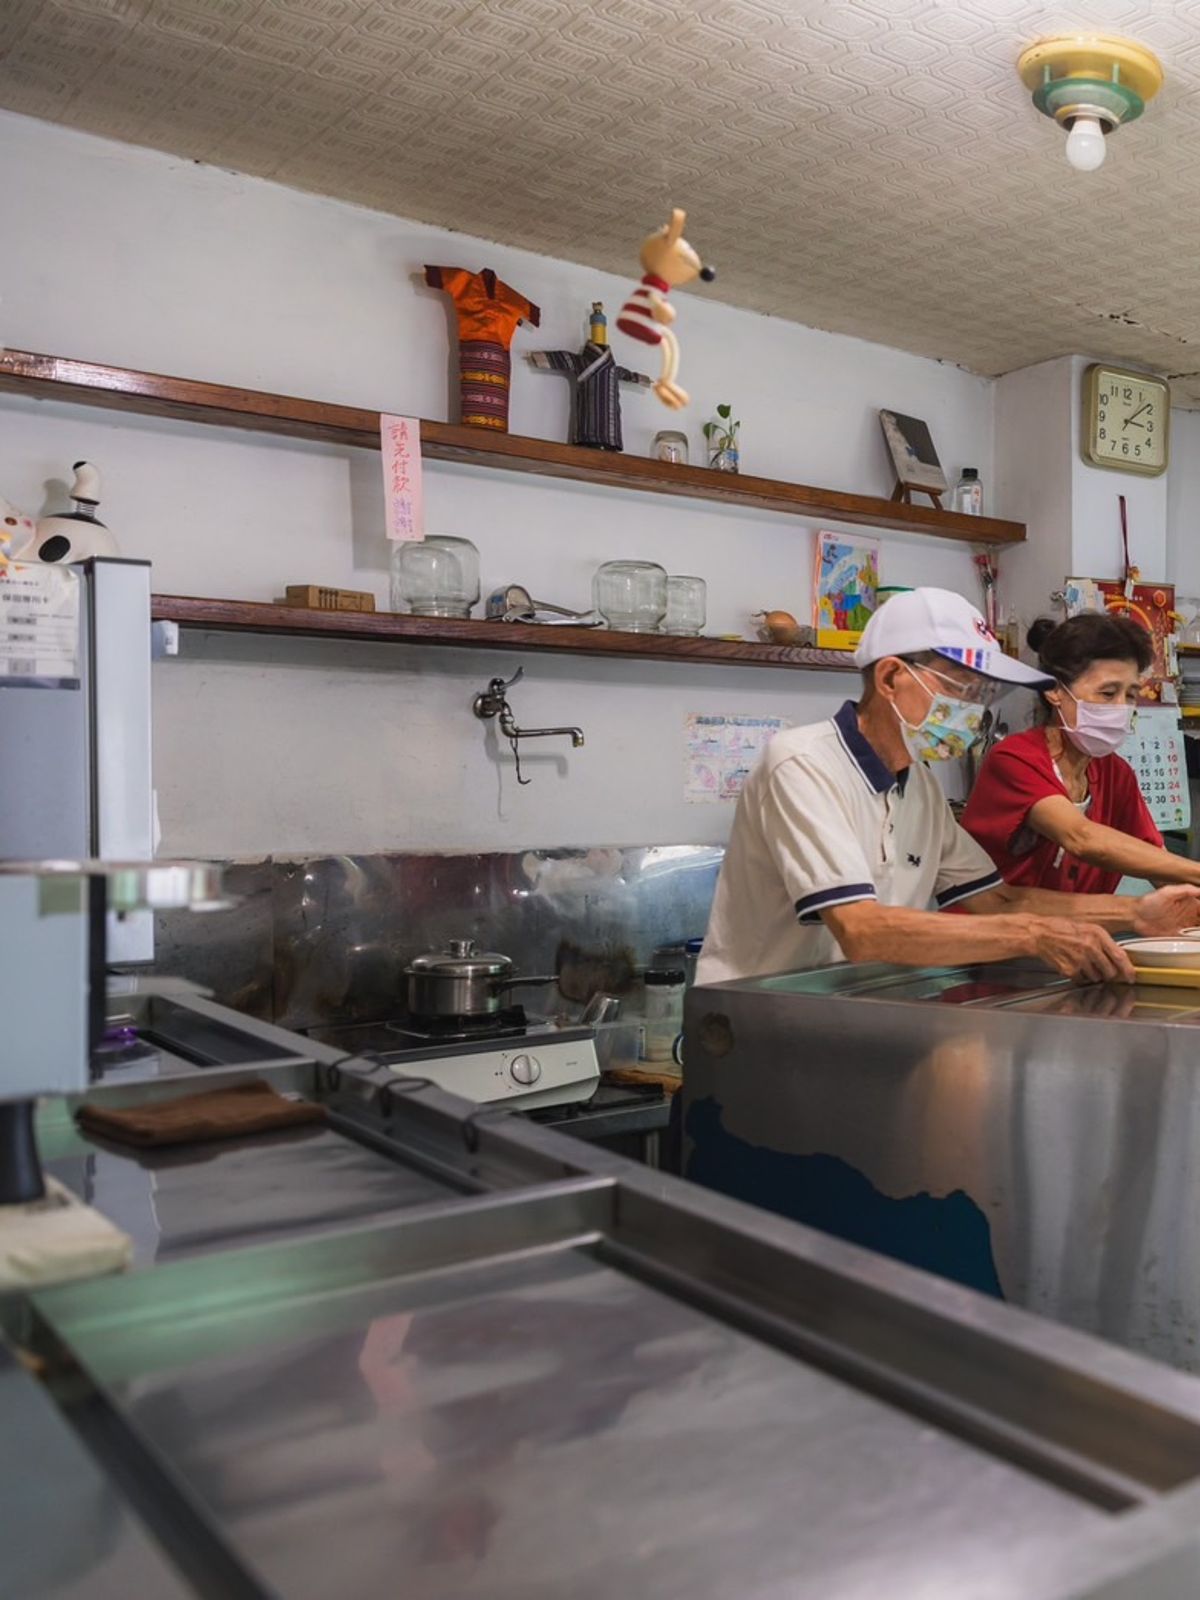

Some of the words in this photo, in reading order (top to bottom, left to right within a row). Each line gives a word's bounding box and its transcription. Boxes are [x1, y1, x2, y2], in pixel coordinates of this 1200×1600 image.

[1110, 385, 1119, 397] 11
[1123, 388, 1133, 400] 12
[1099, 393, 1109, 406] 10
[1146, 404, 1154, 415] 2
[1099, 410, 1106, 422] 9
[1146, 421, 1154, 433] 3
[1099, 428, 1106, 439] 8
[1111, 440, 1117, 451] 7
[1122, 443, 1129, 454] 6
[1145, 438, 1152, 448] 4
[1134, 445, 1141, 456] 5
[1140, 741, 1145, 749] 1
[1154, 741, 1160, 749] 2
[1169, 741, 1175, 749] 3
[1141, 754, 1147, 763] 8
[1155, 754, 1161, 763] 9
[1168, 754, 1178, 763] 10
[1140, 769, 1151, 777] 15
[1154, 769, 1164, 777] 16
[1168, 768, 1178, 776] 17
[1141, 783, 1151, 791] 22
[1154, 782, 1165, 791] 23
[1169, 781, 1180, 790] 24
[1155, 796, 1166, 804] 30
[1170, 795, 1181, 804] 31
